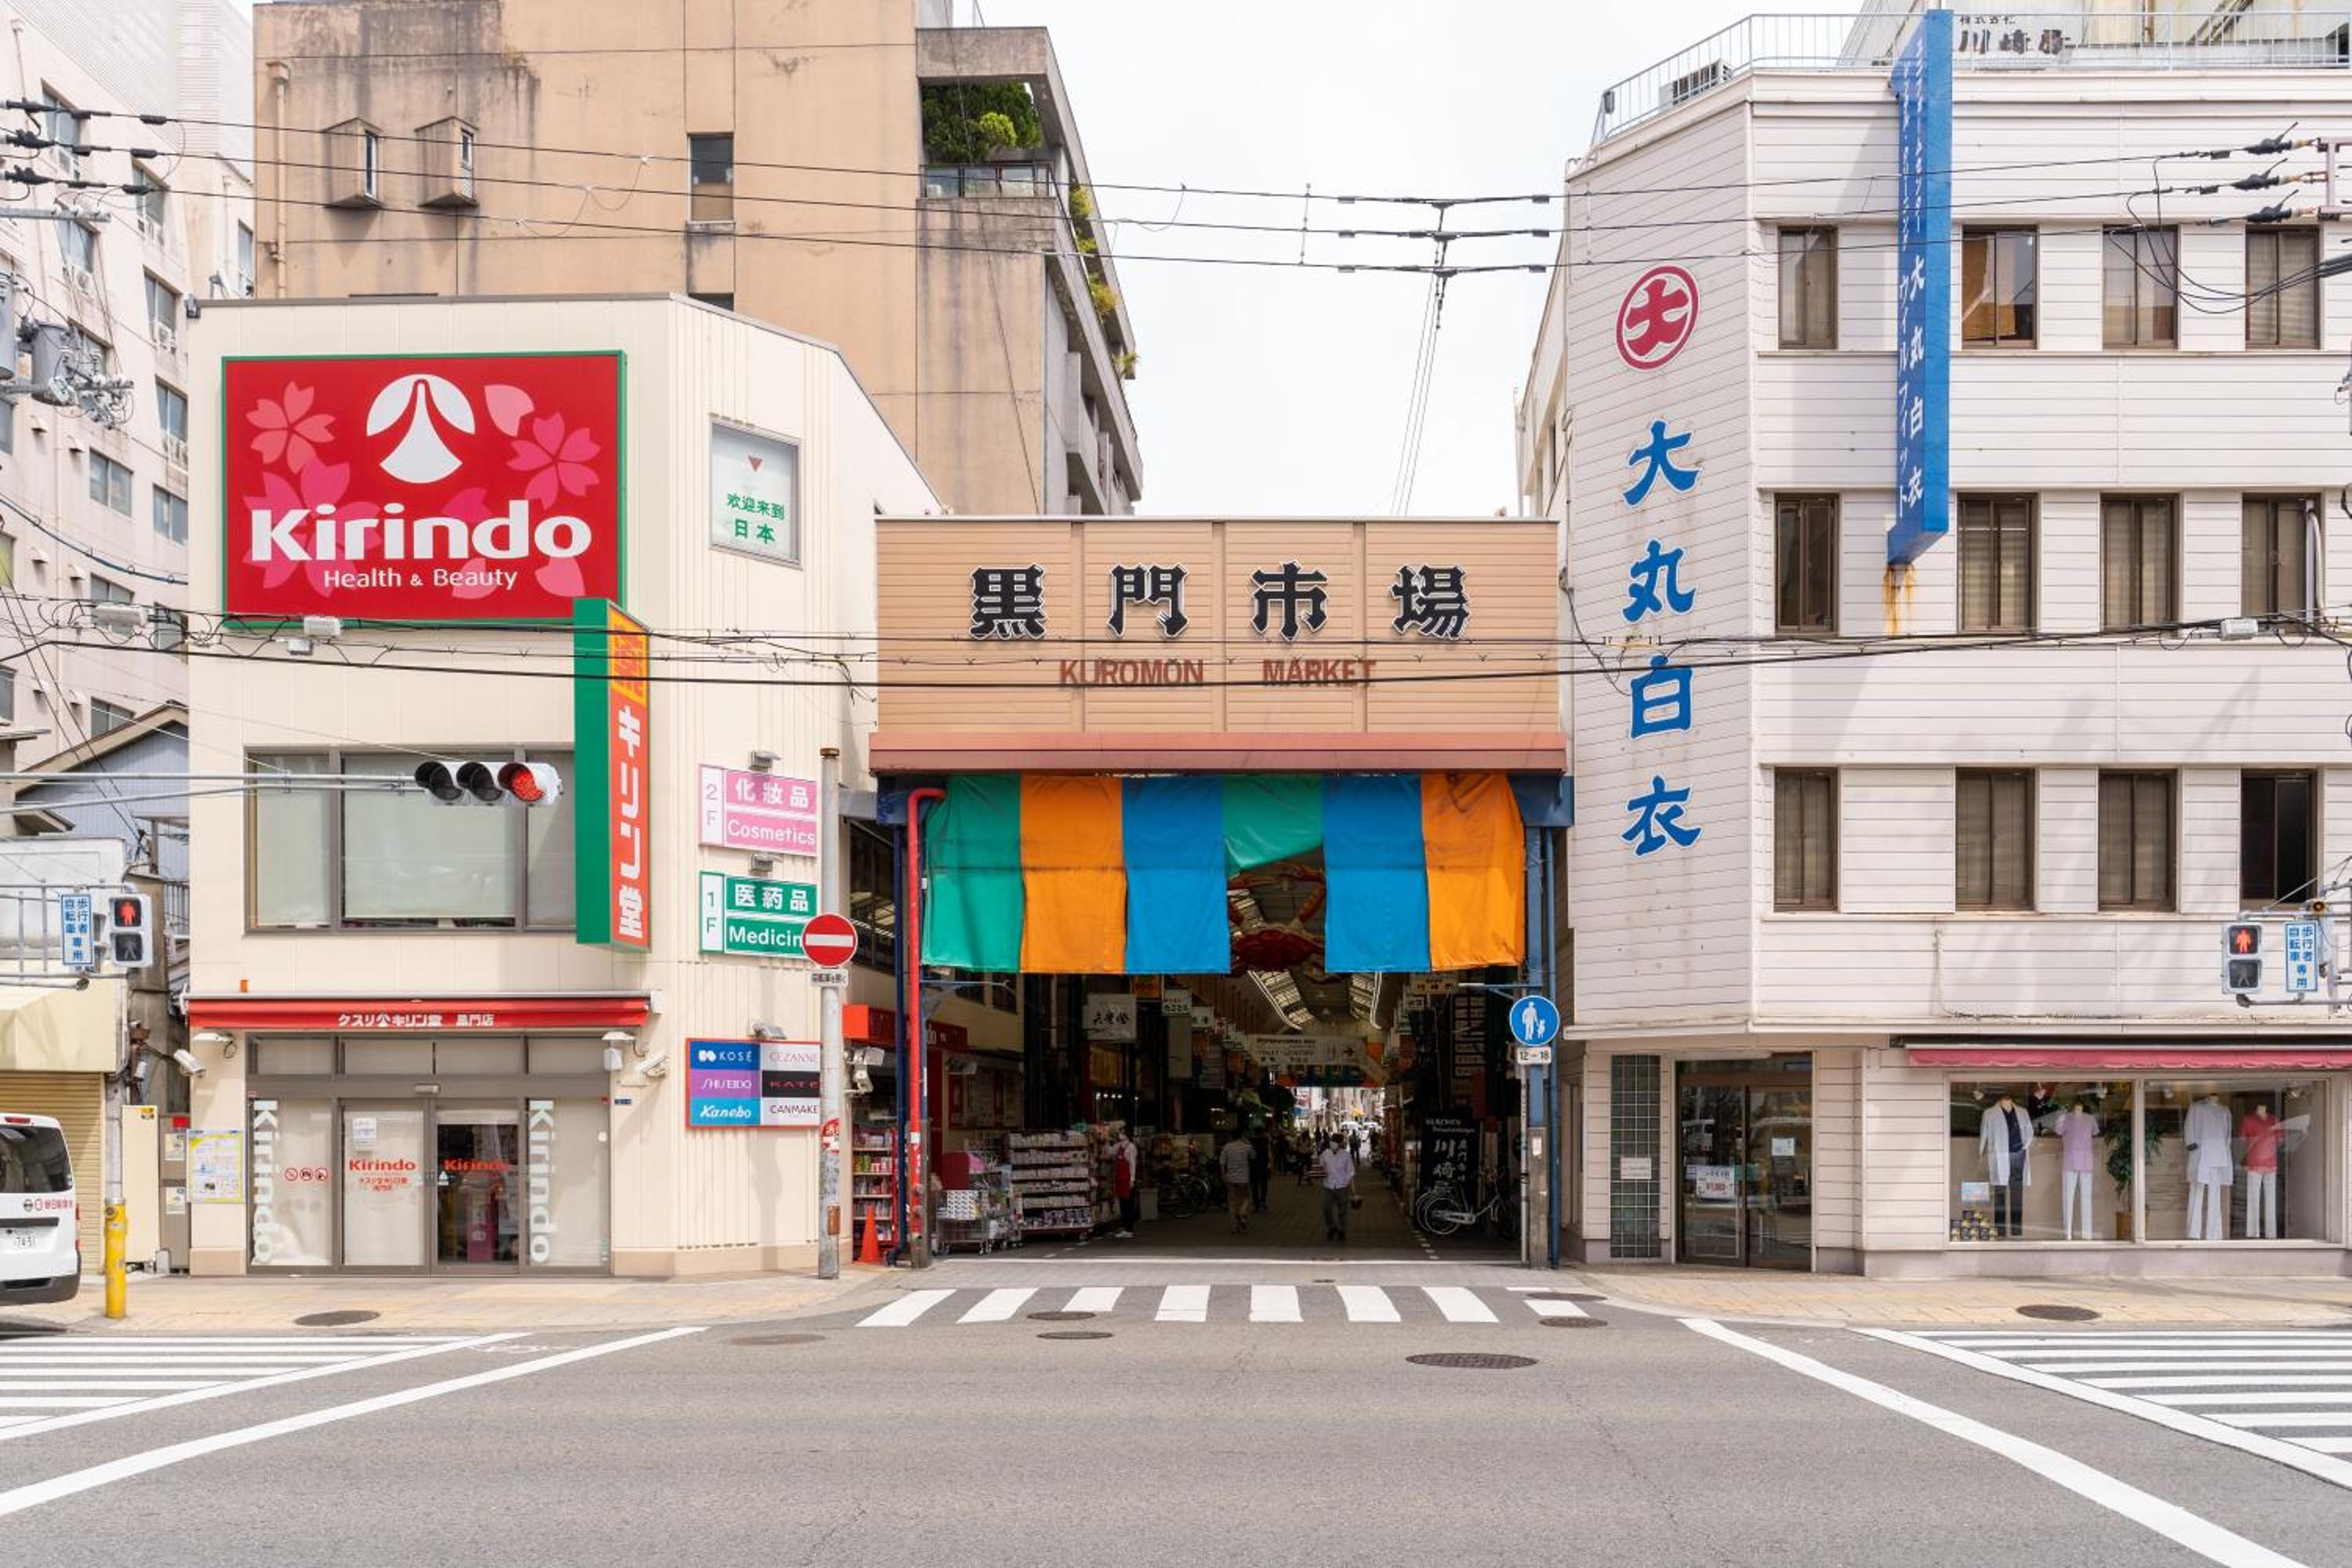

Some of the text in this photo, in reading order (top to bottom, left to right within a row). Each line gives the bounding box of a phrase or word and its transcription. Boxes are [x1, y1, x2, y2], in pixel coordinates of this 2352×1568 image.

[1908, 255, 1926, 510] 大丸白衣
[727, 493, 785, 520] 欢迎来到
[251, 499, 592, 561] Kirindo
[734, 518, 775, 544] 日本
[324, 568, 517, 590] Health & Beauty
[969, 561, 1470, 641] 黒門市場
[1624, 419, 1702, 858] 大丸白衣
[1059, 659, 1376, 688] KUROMON MARKET
[619, 705, 643, 938] キリン堂
[728, 819, 815, 846] Cosmetics
[65, 899, 76, 934] 自転車
[78, 898, 88, 934] 歩行者
[706, 891, 718, 934] 1F
[73, 938, 84, 961] 専用
[728, 925, 804, 947] Medicin
[2288, 928, 2300, 961] 自転車
[2302, 927, 2314, 961] 歩行者
[2296, 964, 2307, 988] 専用
[338, 1014, 375, 1027] クスリ
[392, 1014, 443, 1027] キリン堂
[699, 1104, 752, 1119] Kanebo
[769, 1105, 818, 1114] CANMAKE
[350, 1159, 416, 1171] Kirindo
[254, 1100, 280, 1263] Kirindo
[529, 1100, 557, 1263] Kirindo
